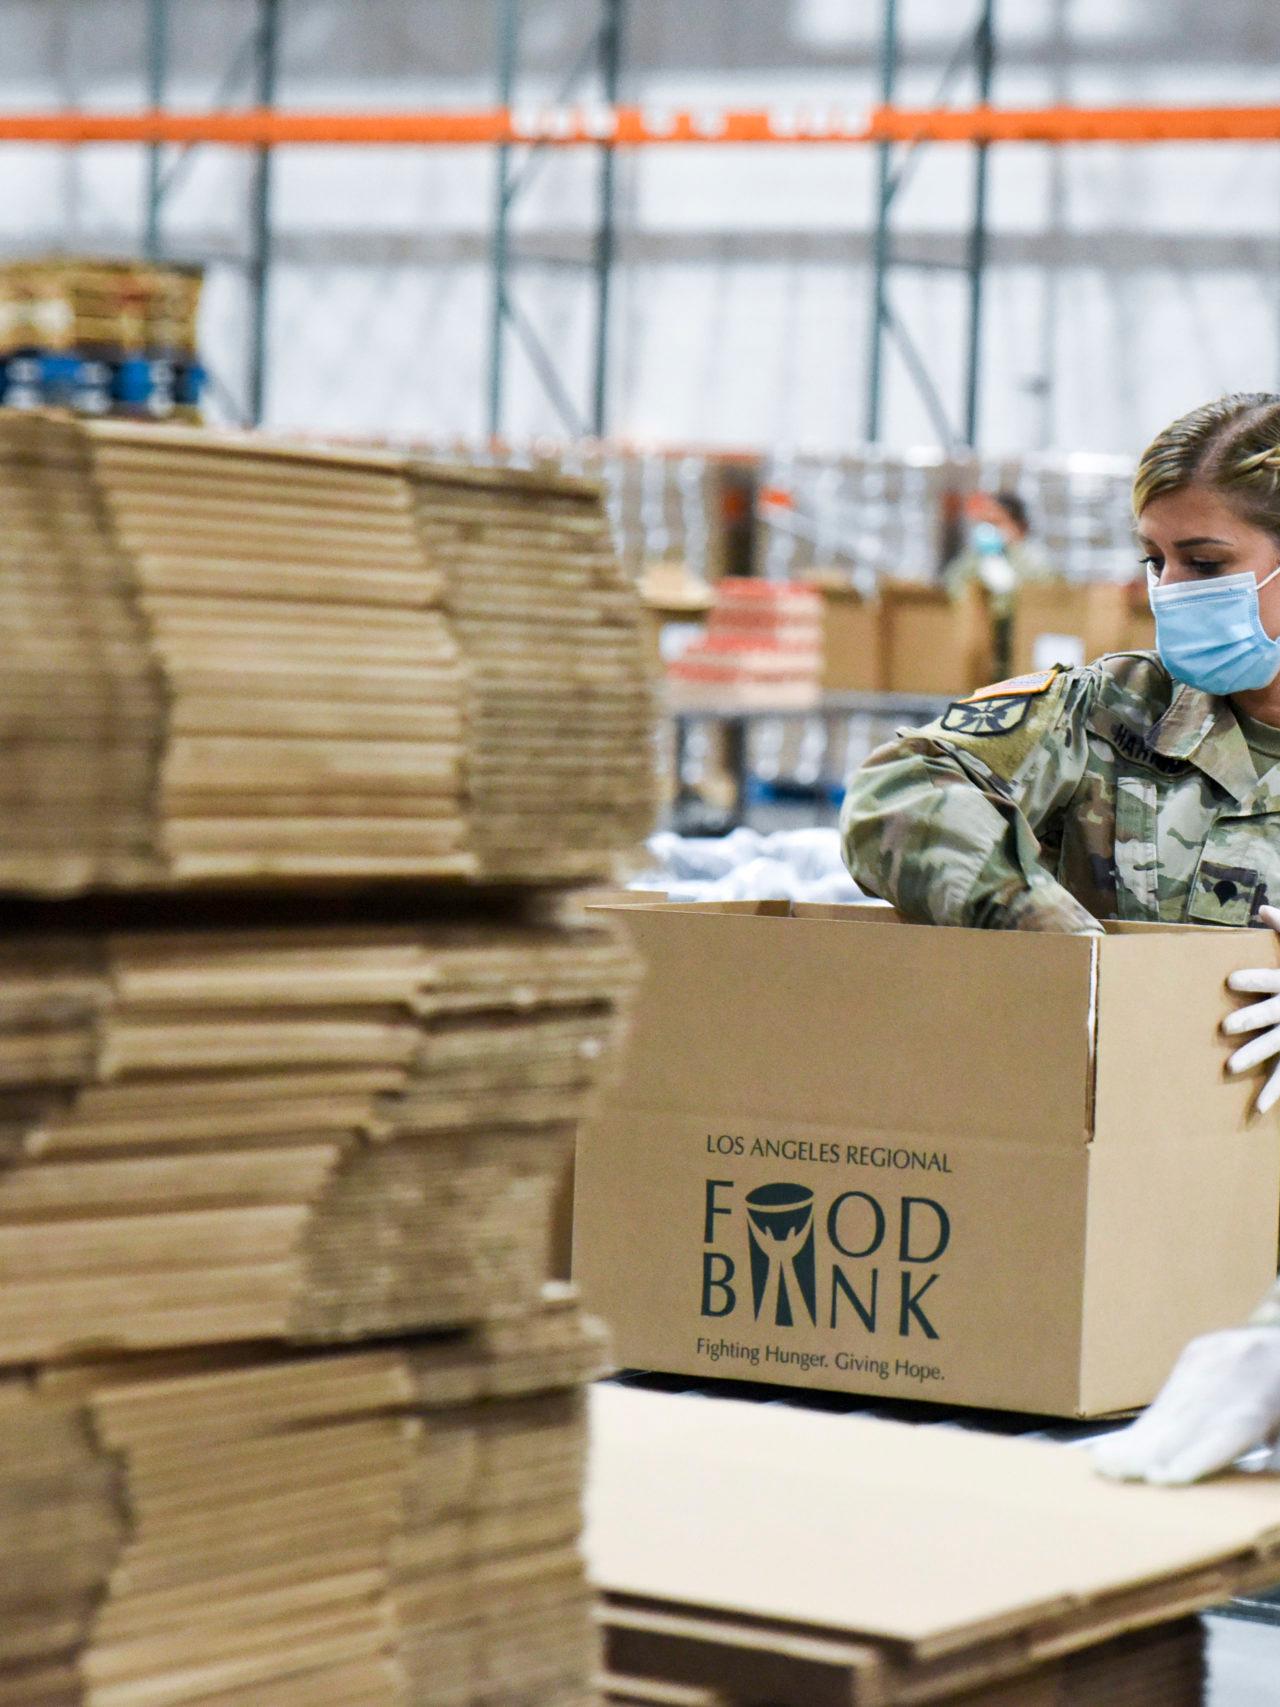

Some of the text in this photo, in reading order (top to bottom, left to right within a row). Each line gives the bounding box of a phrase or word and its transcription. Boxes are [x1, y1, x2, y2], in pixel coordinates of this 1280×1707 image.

[707, 1134, 953, 1173] LOS ANGELES REGIONAL
[696, 1337, 945, 1382] Fighting Hunger. Giving Hope.
